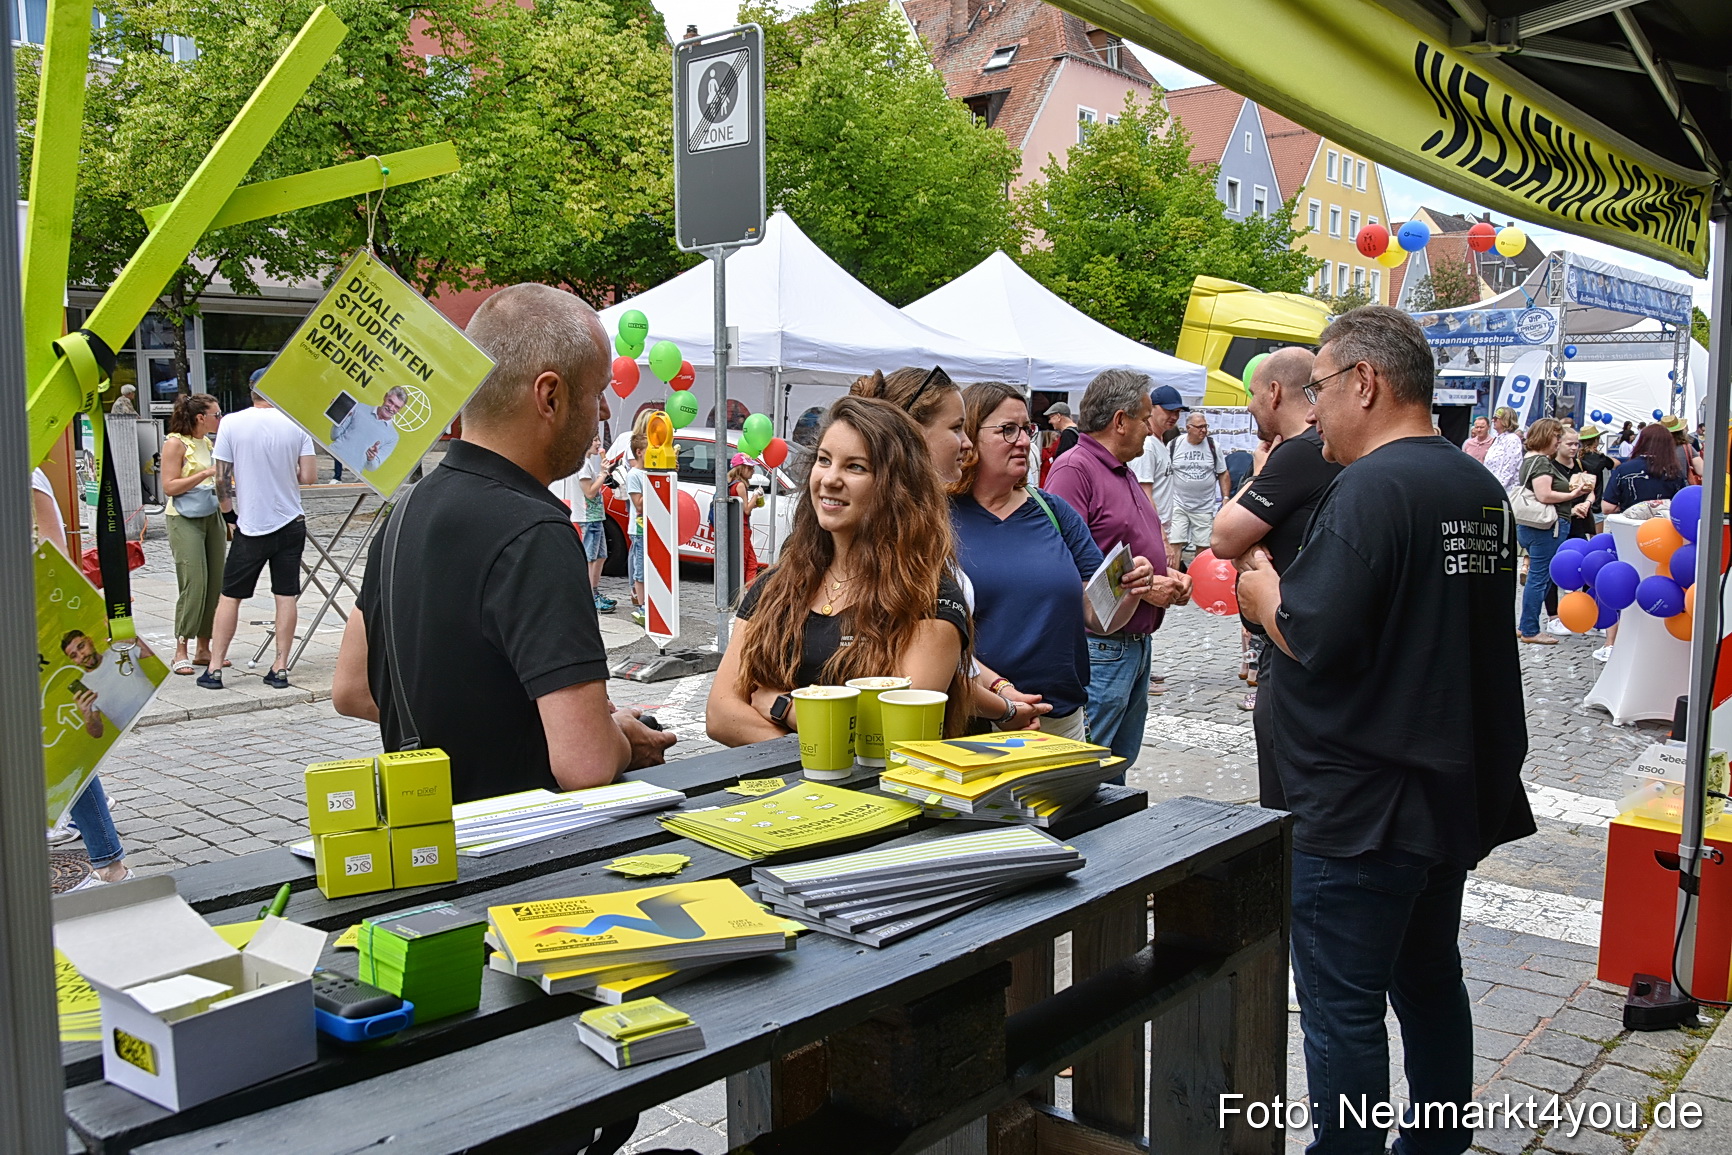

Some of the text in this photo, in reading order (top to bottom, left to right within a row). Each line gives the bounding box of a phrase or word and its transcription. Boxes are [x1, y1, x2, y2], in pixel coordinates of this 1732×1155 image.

[703, 125, 734, 144] ZONE
[346, 277, 405, 331] DUALE
[320, 313, 386, 374] ONLINE-
[335, 294, 435, 382] STUDENTEN
[300, 342, 319, 360] (m/w/d)
[306, 328, 373, 389] MEDIEN
[1184, 451, 1205, 461] KAPPA
[1441, 520, 1498, 536] DU HAST UNS
[1443, 537, 1476, 552] GERDE
[1637, 764, 1665, 775] B500
[838, 803, 875, 817] KEIN
[533, 904, 581, 912] DIGITAL
[535, 906, 592, 915] FESTIVAL
